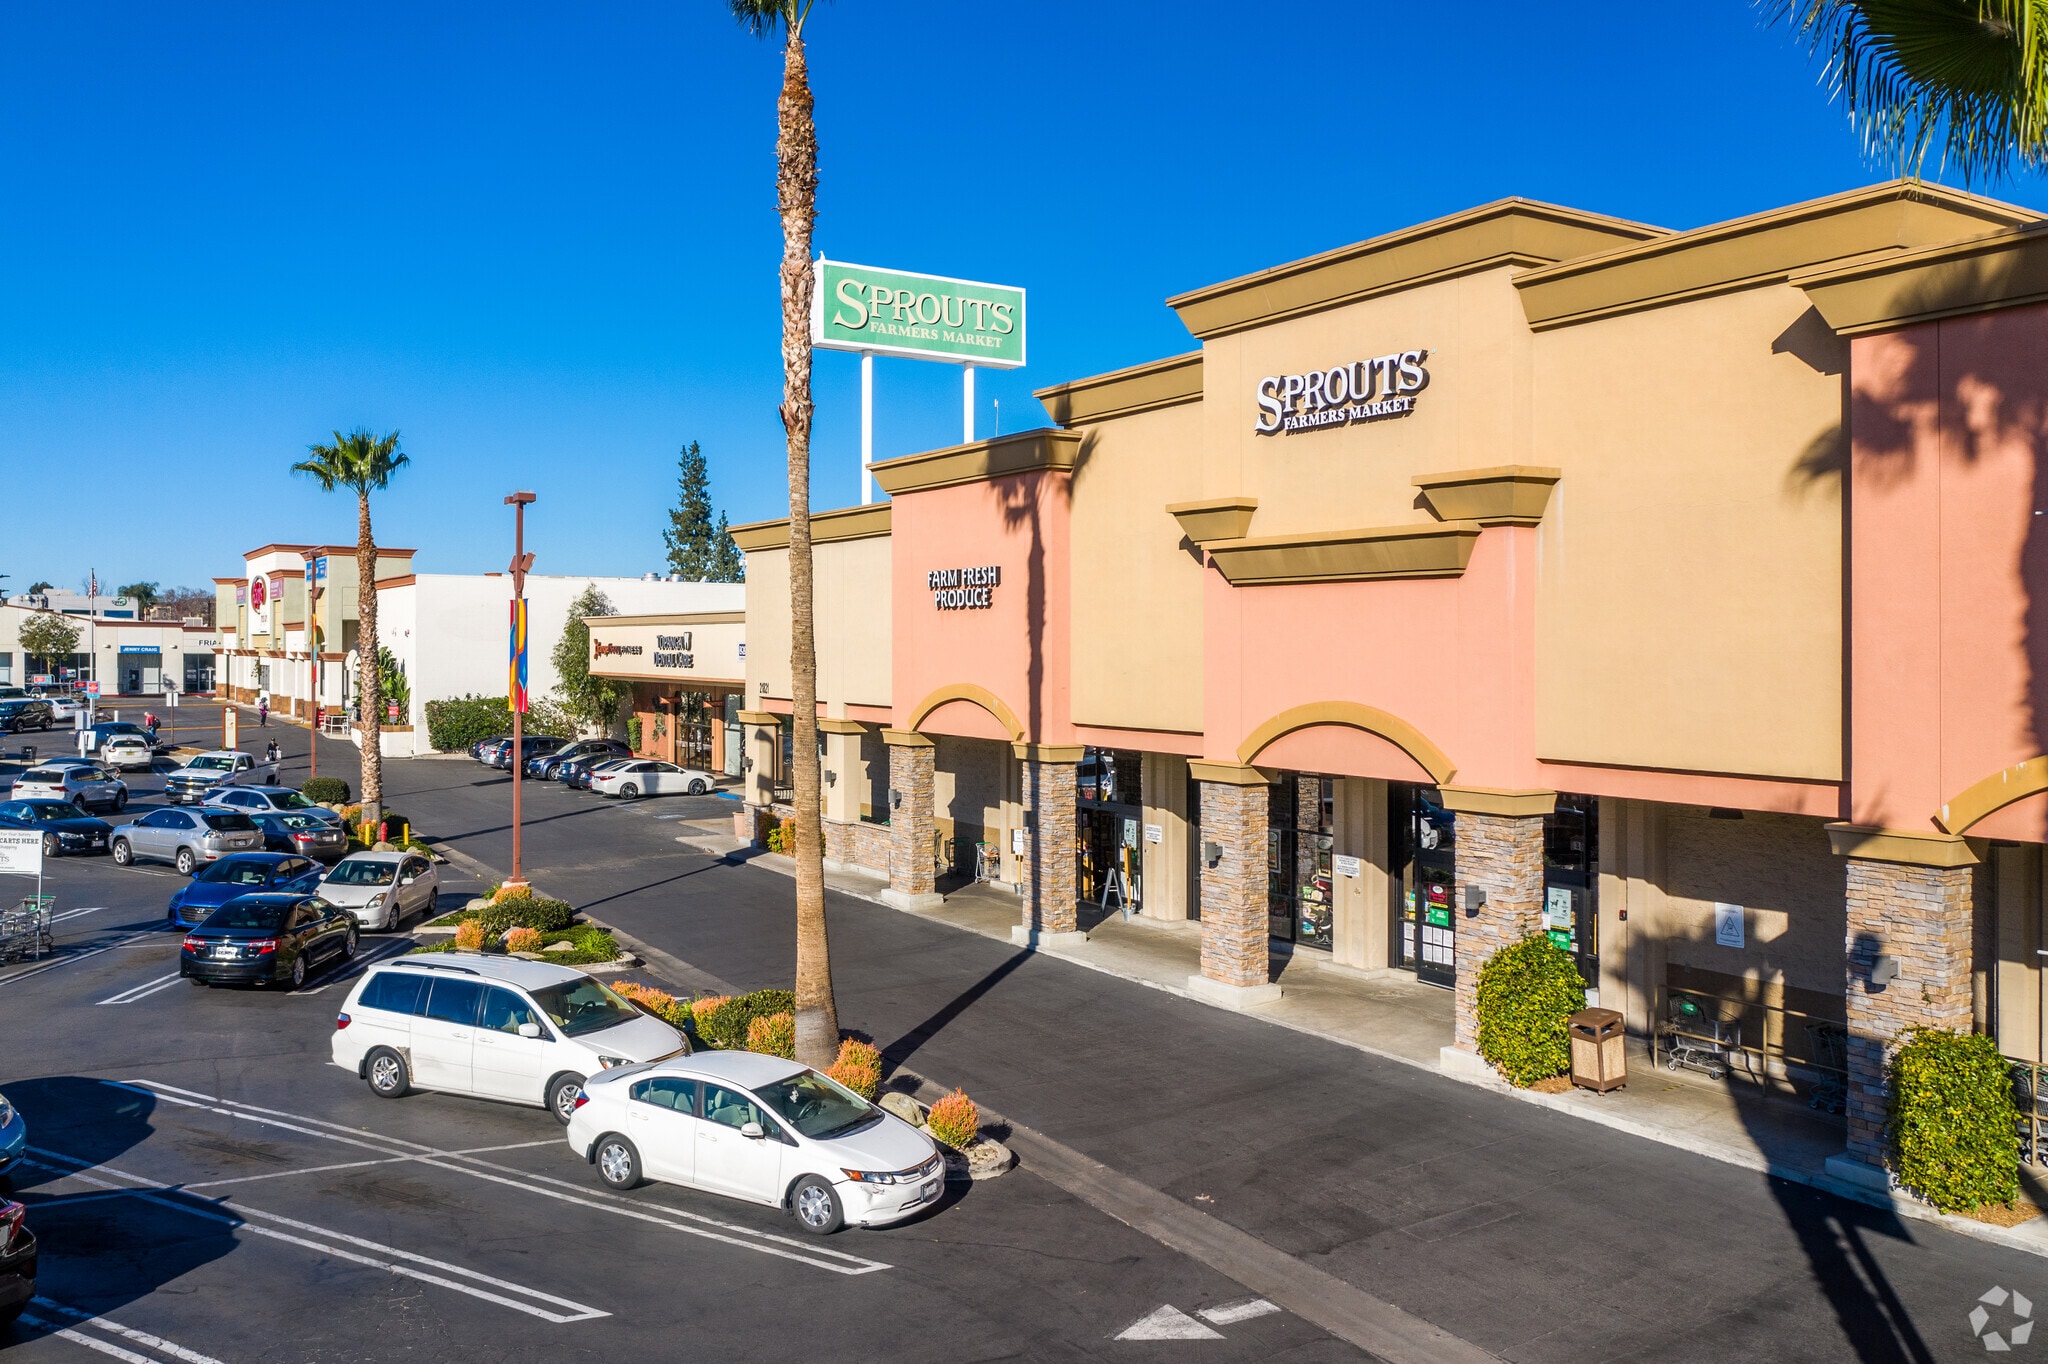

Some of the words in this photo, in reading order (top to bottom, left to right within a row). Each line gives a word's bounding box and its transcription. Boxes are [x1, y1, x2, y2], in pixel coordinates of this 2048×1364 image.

[832, 278, 1015, 335] SPROUTS
[870, 321, 938, 341] FARMERS
[942, 330, 1002, 348] MARKET
[1254, 350, 1428, 434] SPROUTS
[1284, 409, 1346, 433] FARMERS
[1349, 397, 1414, 422] MARKET
[927, 569, 958, 588] FARM
[962, 566, 998, 586] FRESH
[934, 588, 990, 608] PRODUCE
